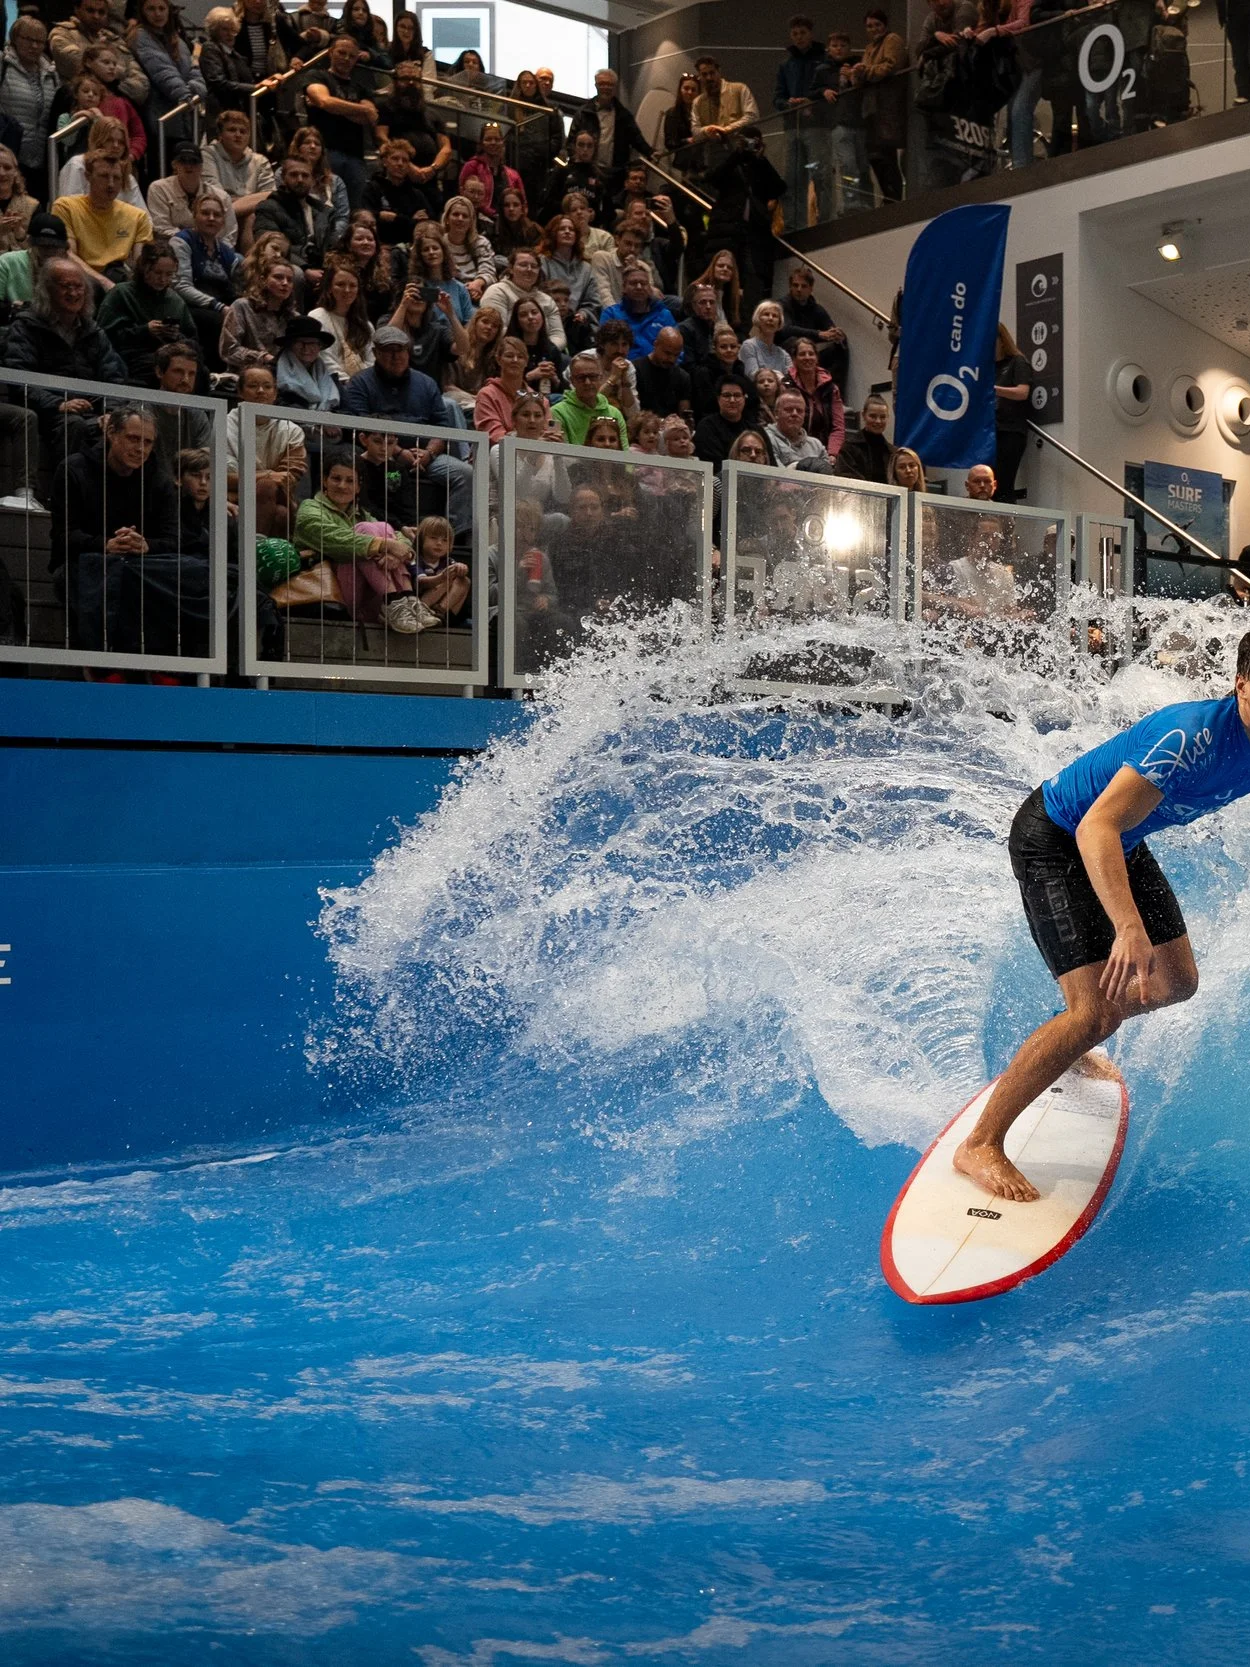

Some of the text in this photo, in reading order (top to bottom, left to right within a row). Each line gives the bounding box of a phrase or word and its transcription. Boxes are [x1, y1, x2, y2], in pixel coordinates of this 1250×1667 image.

[1078, 24, 1136, 100] O2
[951, 282, 967, 309] do
[950, 315, 963, 352] can
[1167, 499, 1202, 513] MASTERS
[1168, 484, 1202, 502] SURF
